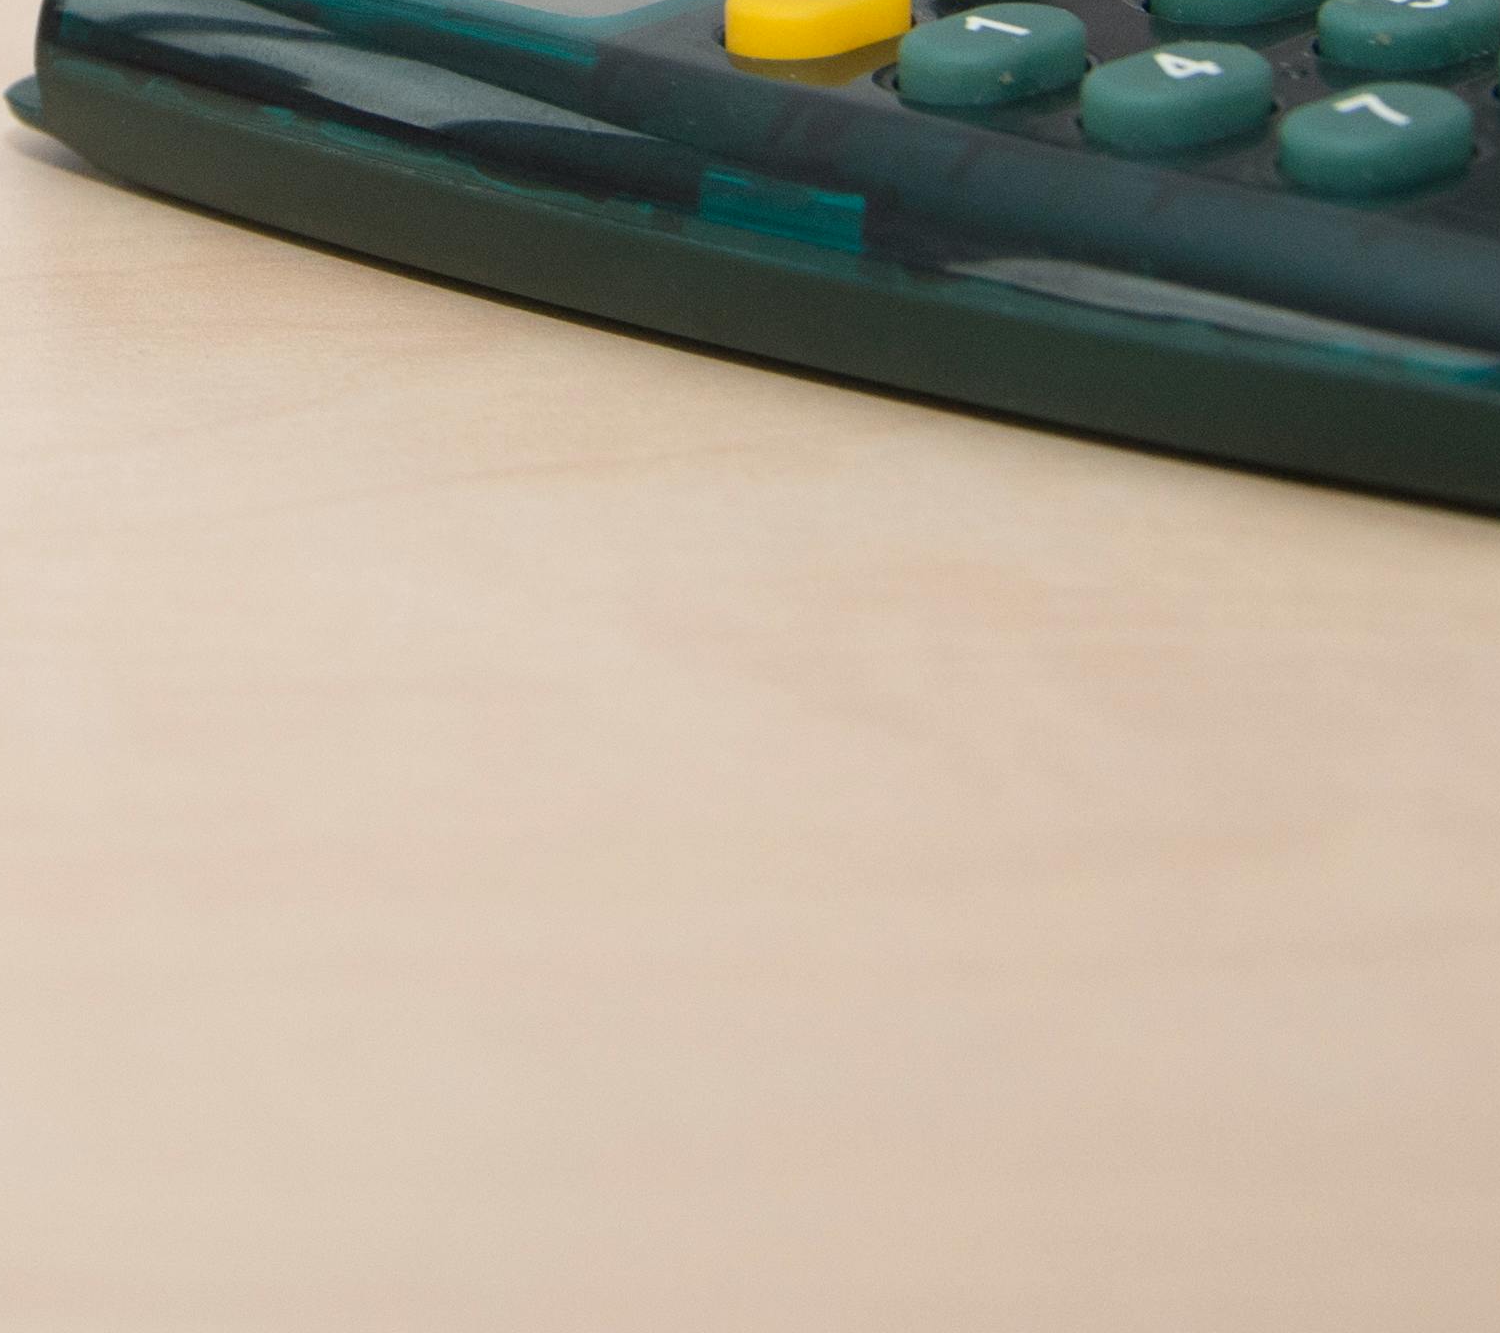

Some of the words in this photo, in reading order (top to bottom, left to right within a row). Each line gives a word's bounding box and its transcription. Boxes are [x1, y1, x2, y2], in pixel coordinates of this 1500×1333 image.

[964, 16, 1032, 35] 1
[1153, 51, 1223, 79] 4
[1333, 92, 1413, 127] 7
